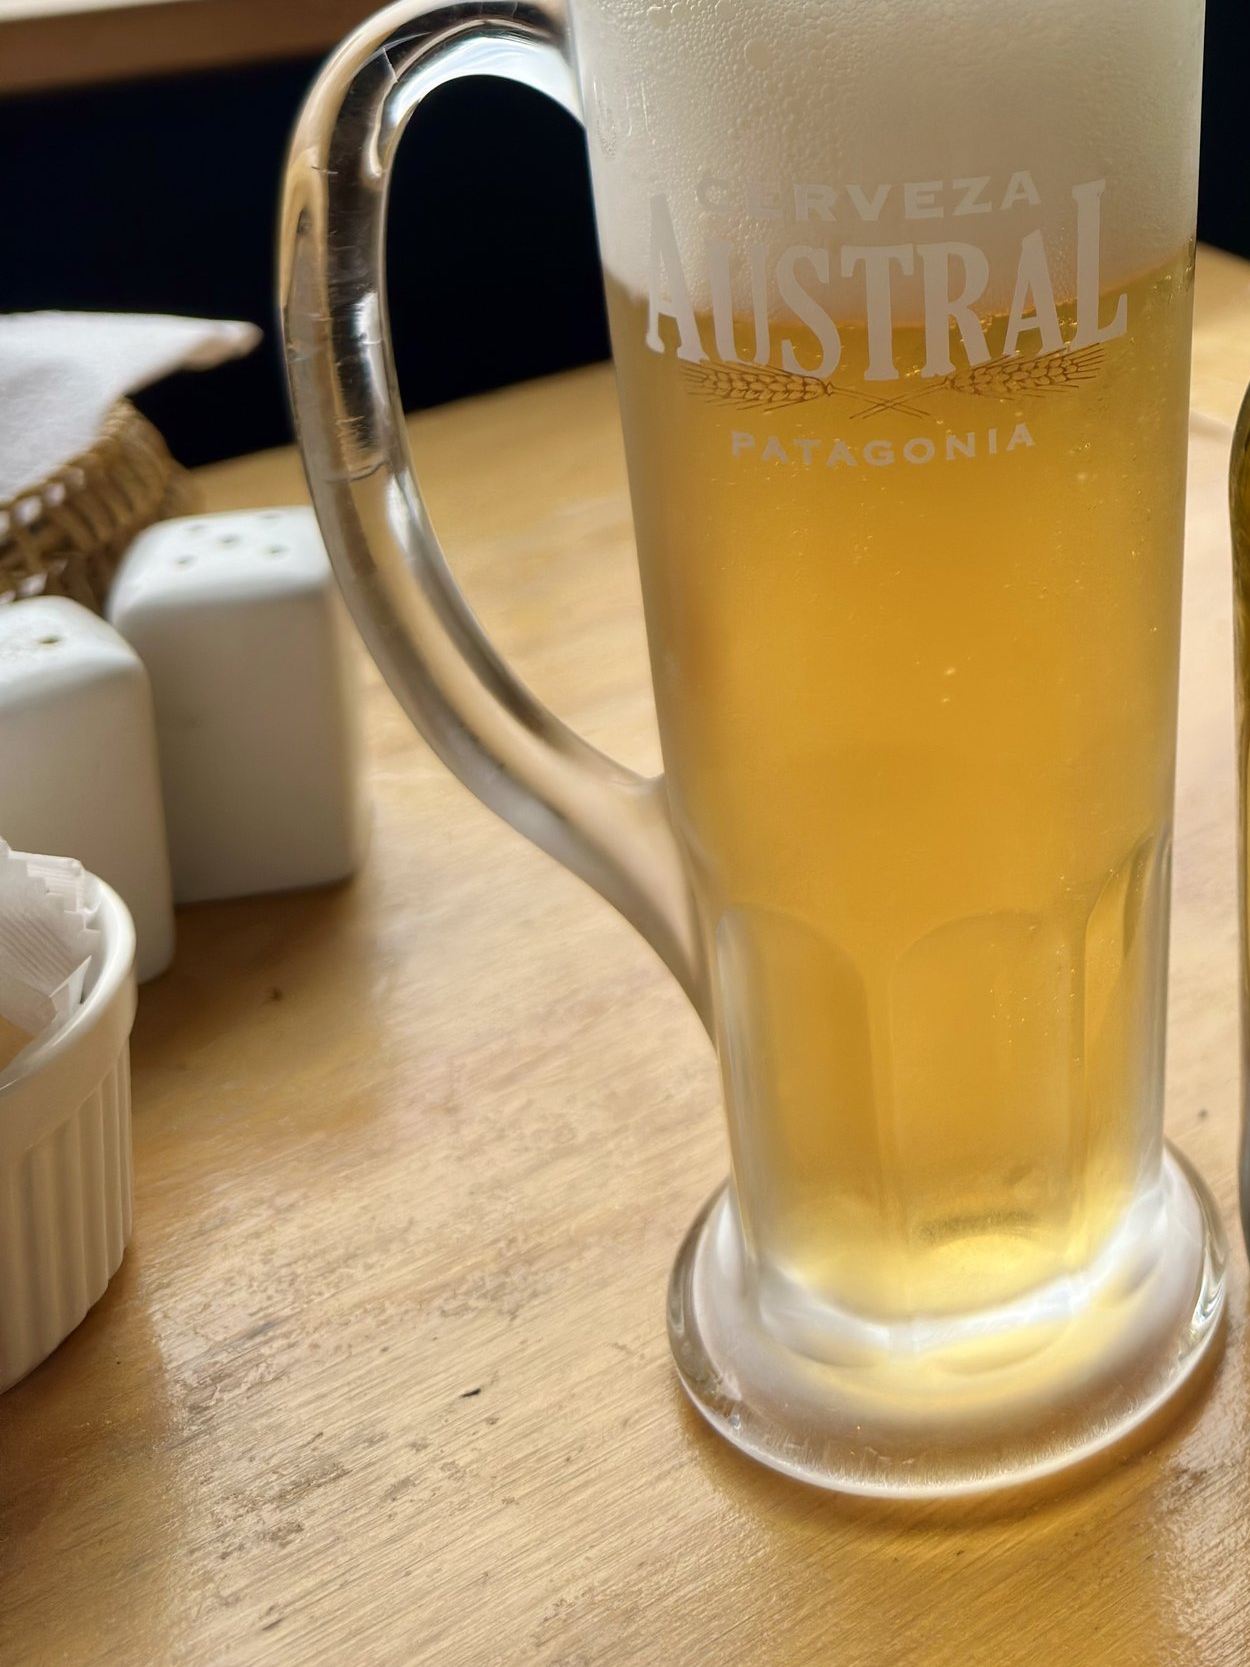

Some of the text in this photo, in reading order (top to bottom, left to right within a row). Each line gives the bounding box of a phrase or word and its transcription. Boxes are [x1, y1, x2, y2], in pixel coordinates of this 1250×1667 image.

[698, 169, 1043, 223] CERVEZA
[645, 179, 1128, 382] AUSTRAL
[730, 422, 1037, 468] PATAGONIA
